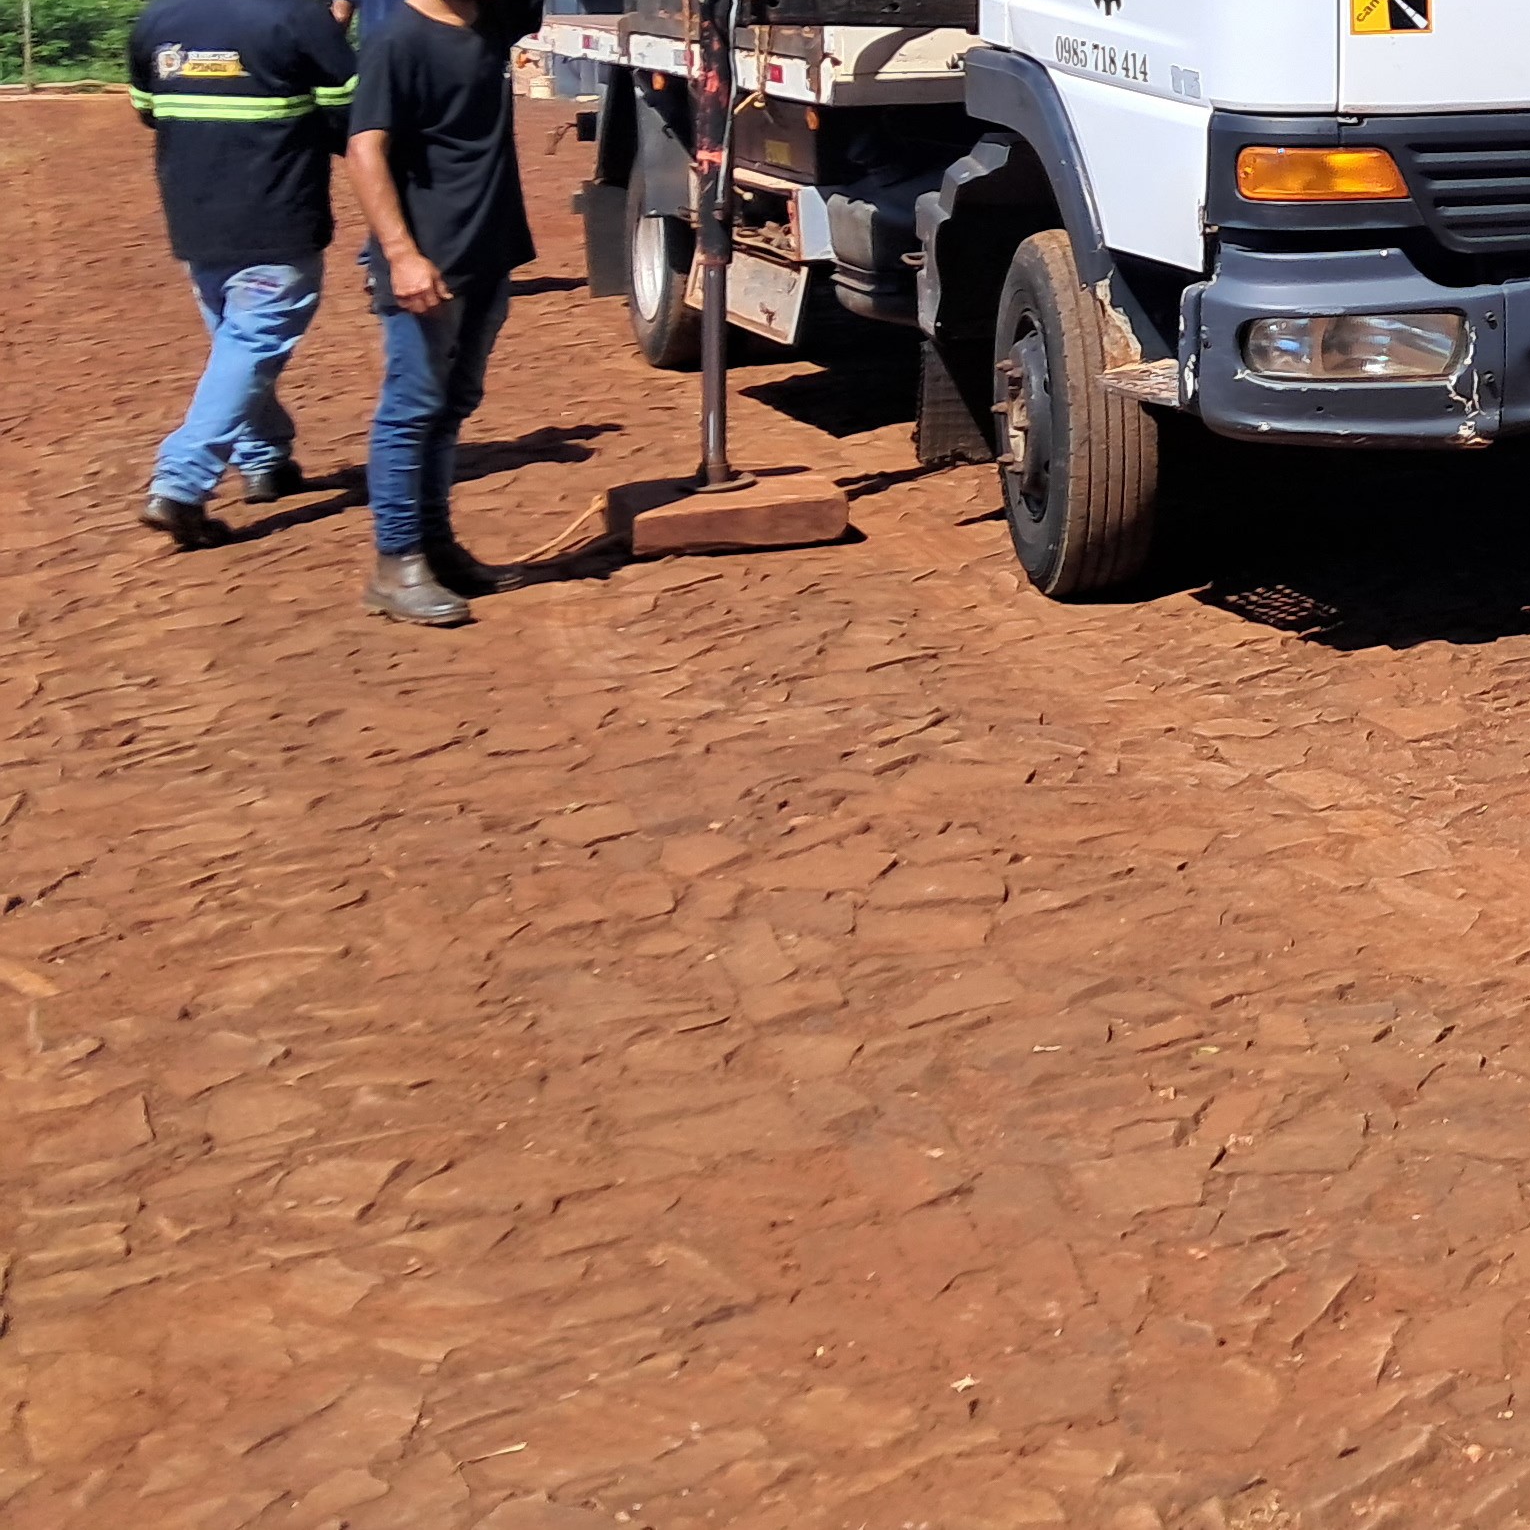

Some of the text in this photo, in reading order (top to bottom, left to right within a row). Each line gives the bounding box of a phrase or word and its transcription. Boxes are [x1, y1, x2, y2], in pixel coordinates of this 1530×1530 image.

[1055, 35, 1088, 68] 0985
[1091, 42, 1118, 76] 718
[1121, 49, 1149, 83] 414
